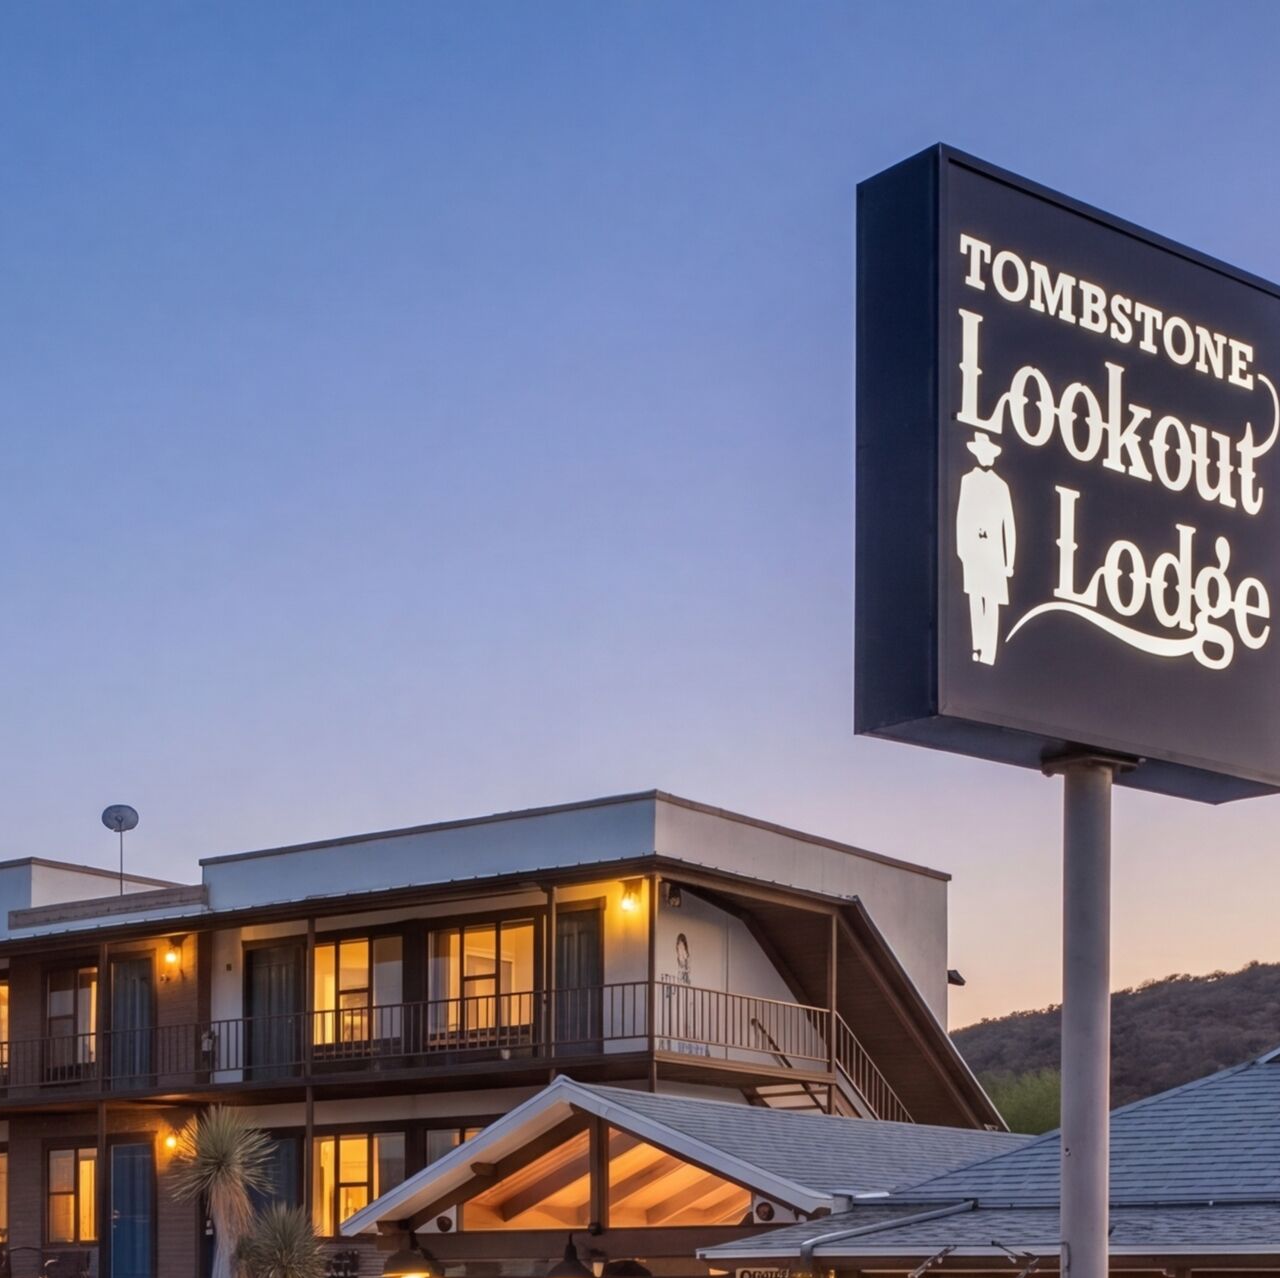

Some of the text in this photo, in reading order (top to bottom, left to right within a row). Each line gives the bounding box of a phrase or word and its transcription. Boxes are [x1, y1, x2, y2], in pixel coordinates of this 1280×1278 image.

[960, 233, 1254, 391] TOMBSTONE
[956, 308, 1280, 516] Lookout
[1005, 484, 1271, 671] Lodge
